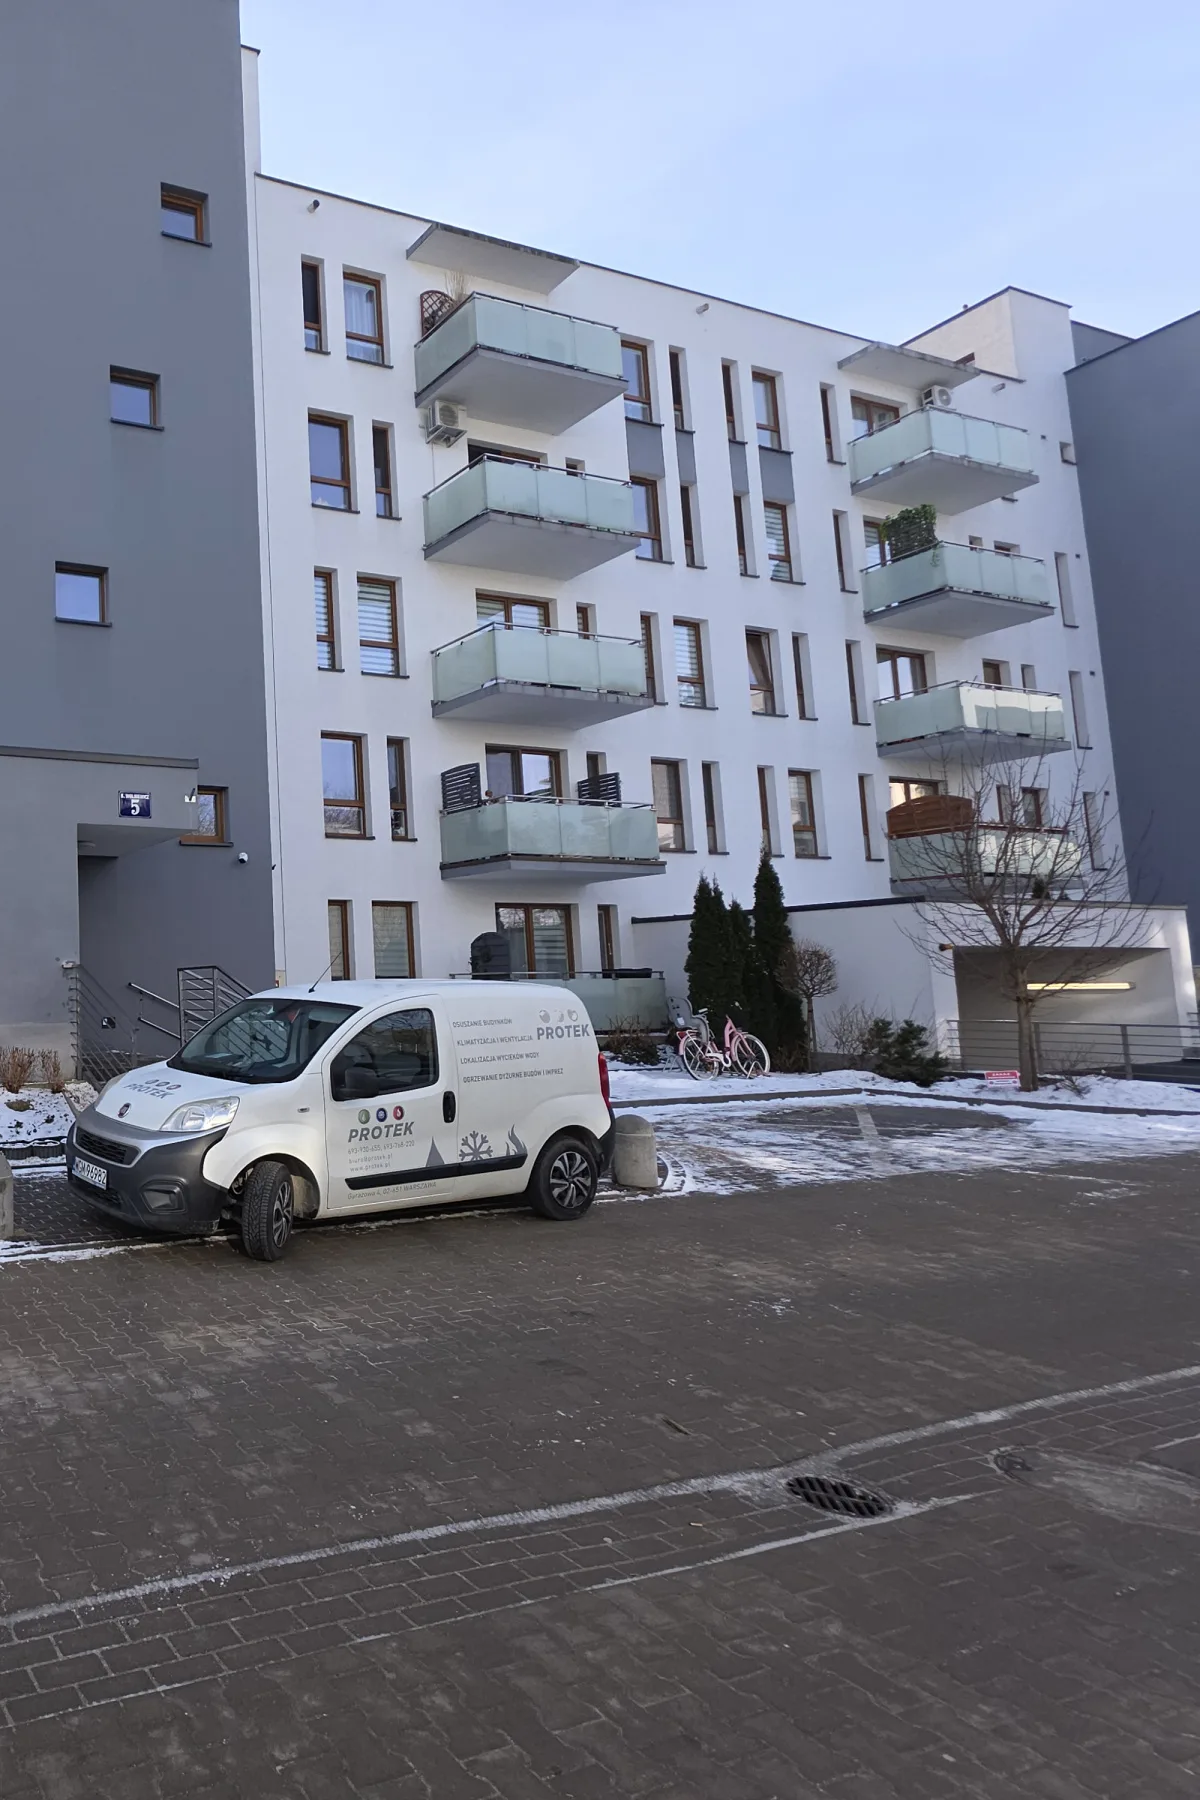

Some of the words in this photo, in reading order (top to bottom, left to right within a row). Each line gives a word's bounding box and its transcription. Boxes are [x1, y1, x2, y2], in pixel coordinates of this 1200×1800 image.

[131, 799, 140, 815] 5
[453, 1020, 482, 1028] OSUSZANIE
[483, 1018, 512, 1026] BUDYNKÓW
[457, 1037, 497, 1046] KLIMATYZACJA
[500, 1034, 533, 1043] WENTYLACJA
[536, 1024, 590, 1040] PROTEK
[460, 1055, 496, 1064] LOKALIZACJA
[497, 1053, 524, 1061] WYCIEKÓW
[463, 1073, 498, 1083] OGRZEWANIE
[545, 1067, 564, 1075] IMPREZ
[123, 1083, 175, 1099] PROTEK
[348, 1121, 415, 1143] PROTEK
[403, 1181, 437, 1191] WARSZAWA
